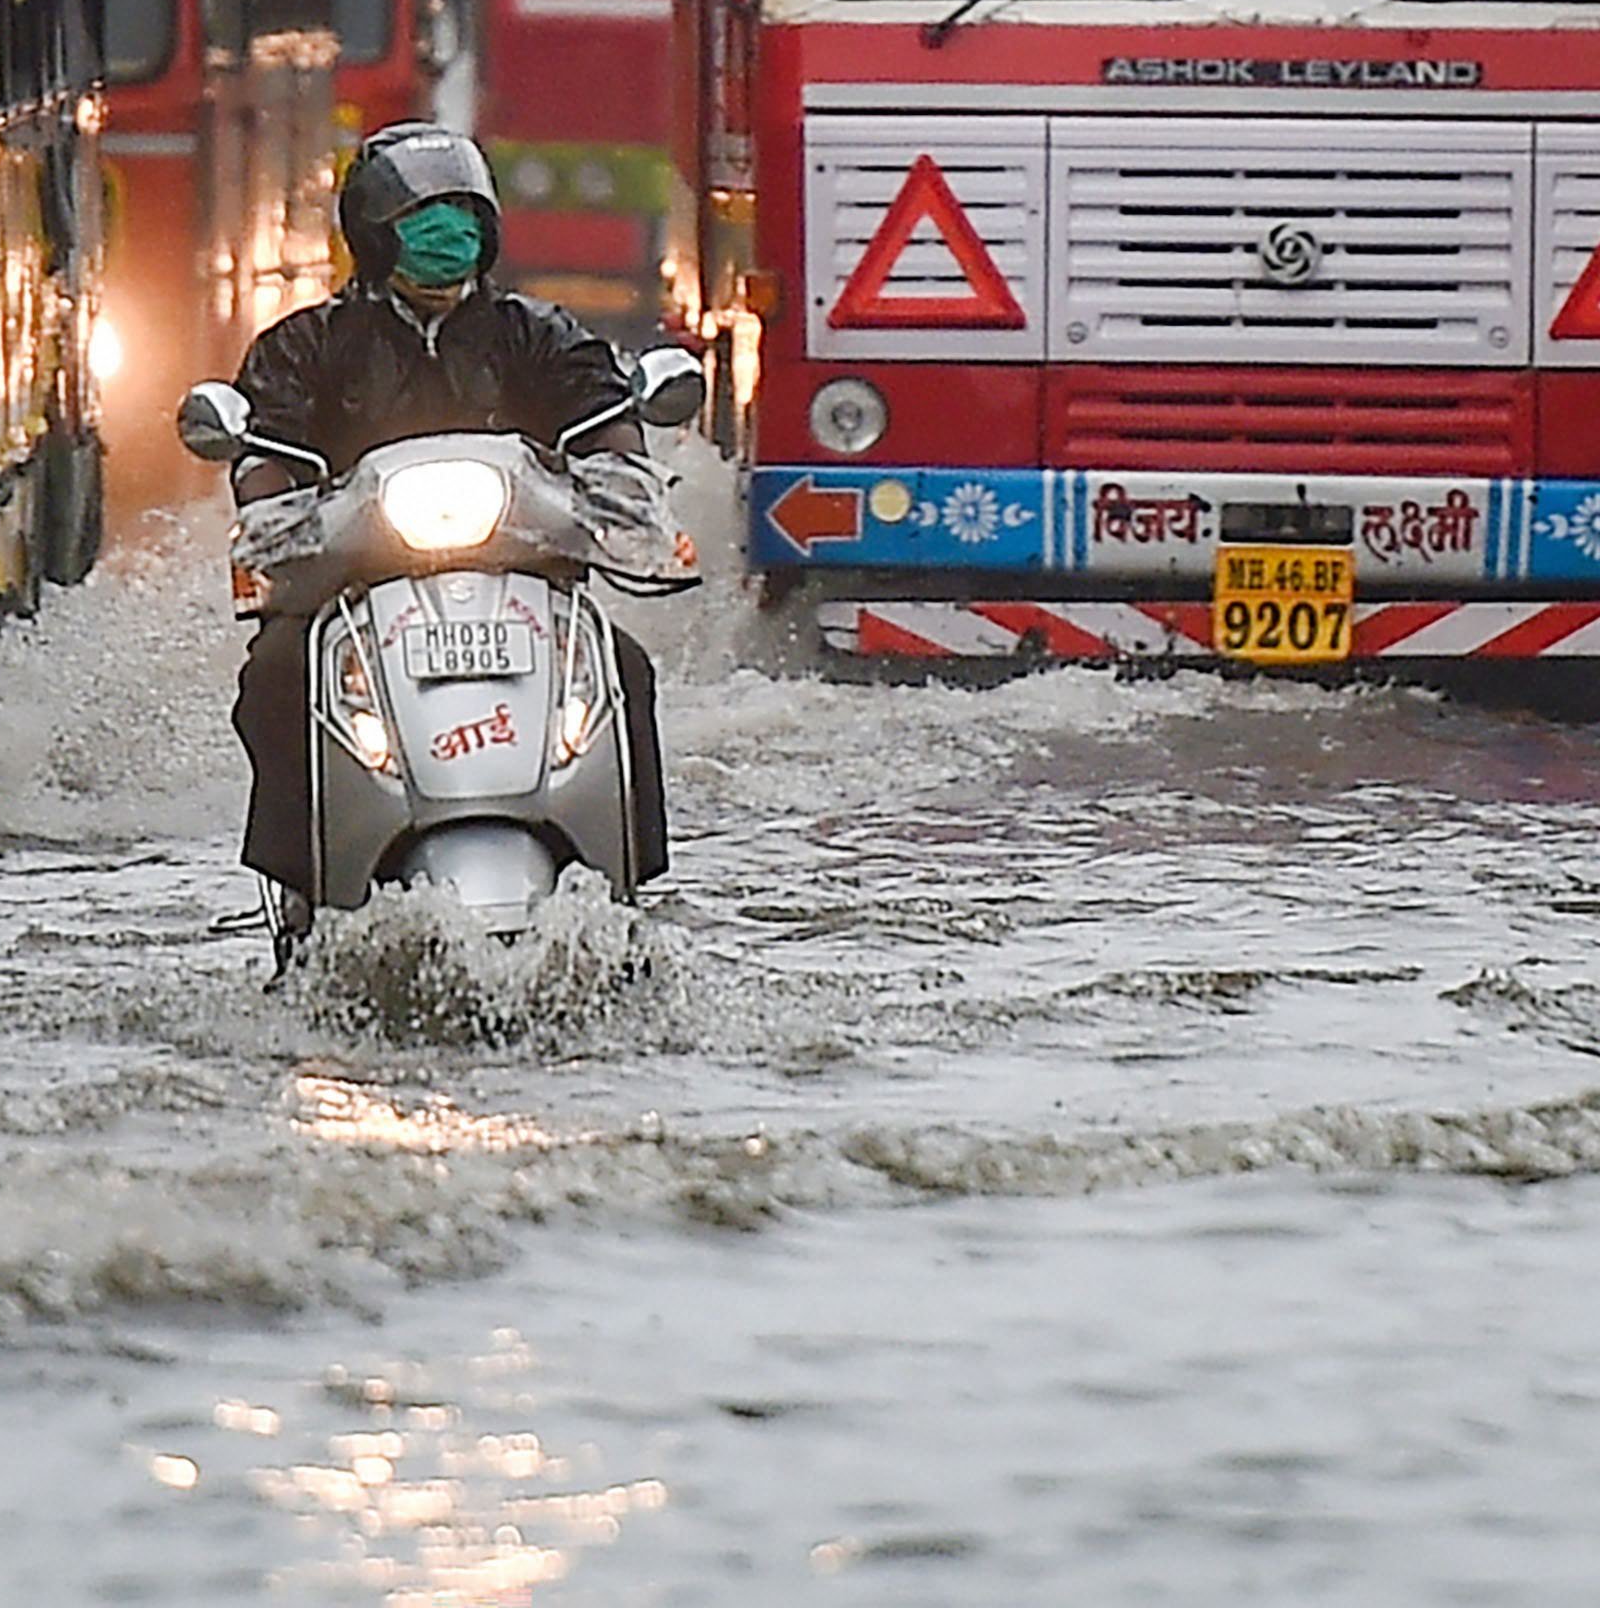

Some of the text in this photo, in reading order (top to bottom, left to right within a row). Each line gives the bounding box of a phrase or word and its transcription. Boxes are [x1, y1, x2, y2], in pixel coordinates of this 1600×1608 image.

[1106, 58, 1478, 84] ASHOK LEYLAND
[1224, 601, 1349, 651] 9207
[428, 648, 511, 673] L8905
[430, 702, 518, 760] आई
